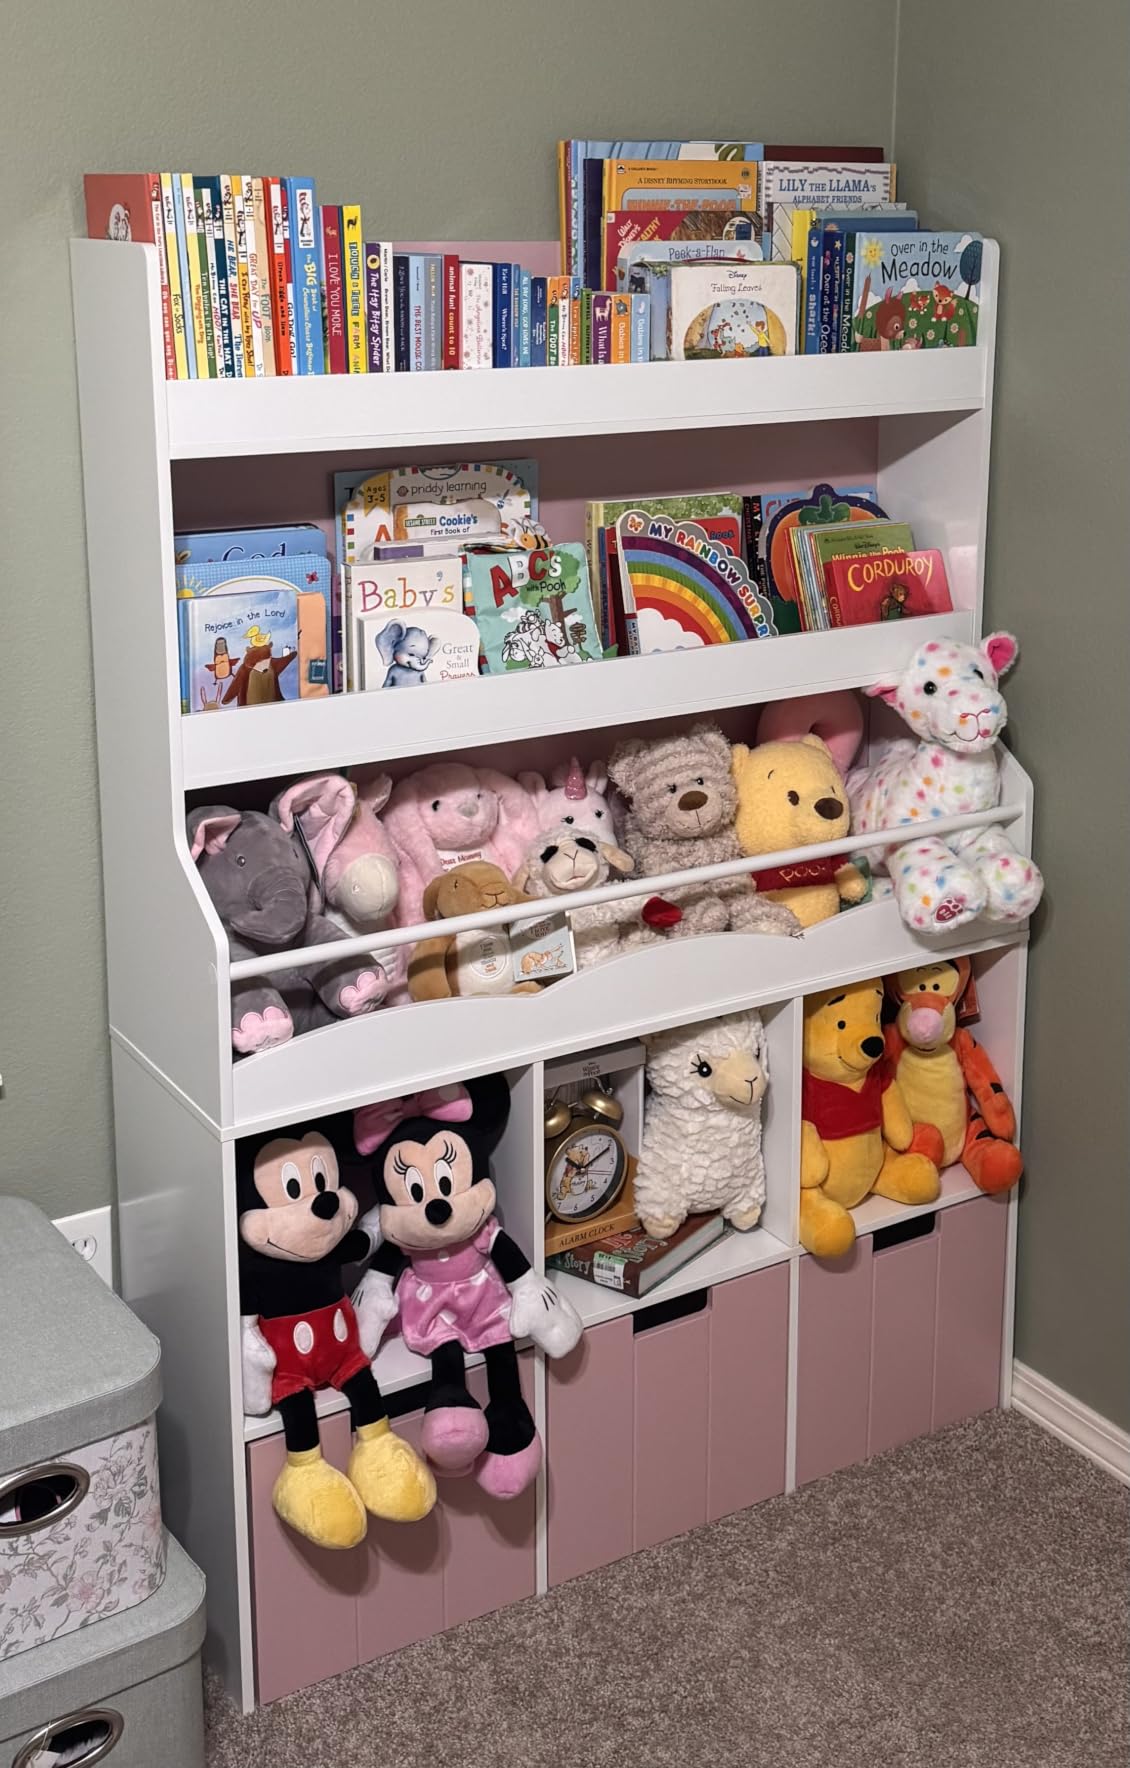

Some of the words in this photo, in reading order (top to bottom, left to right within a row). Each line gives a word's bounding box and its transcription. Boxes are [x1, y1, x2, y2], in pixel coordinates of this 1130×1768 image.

[779, 179, 806, 192] LILY
[809, 183, 826, 192] THE
[828, 180, 876, 192] LLAMA'S
[792, 195, 830, 204] ALPHABET
[832, 195, 862, 204] FRIENDS
[228, 240, 234, 252] HE
[890, 242, 916, 256] Over
[919, 240, 928, 254] in
[932, 239, 948, 254] the
[249, 253, 258, 276] GREAT
[349, 242, 360, 280] TOUCH
[880, 250, 958, 284] Meadow
[304, 262, 318, 286] BIG
[330, 262, 341, 286] LOVE
[370, 273, 380, 288] The
[727, 270, 748, 280] Disney
[218, 278, 228, 295] THE
[230, 282, 238, 300] SHE
[251, 280, 260, 297] DAY
[711, 283, 736, 295] Falling
[738, 282, 763, 292] Leaves
[824, 274, 832, 294] Over
[173, 294, 181, 306] Fox
[202, 288, 210, 315] Apples
[242, 292, 251, 310] Read
[331, 286, 342, 306] YOU
[369, 289, 380, 308] Itsy
[824, 296, 830, 305] at
[221, 298, 230, 316] CAT
[232, 302, 241, 320] BEAR
[261, 294, 271, 321] FOOT
[822, 308, 831, 322] the
[174, 314, 184, 334] Socks
[213, 306, 221, 332] MOO!
[222, 318, 230, 327] IN
[252, 310, 262, 328] UP
[332, 309, 342, 336] MORE
[370, 310, 381, 336] Bitsy
[234, 334, 244, 352] The
[352, 322, 360, 350] FARM
[449, 336, 455, 345] to
[550, 333, 558, 355] FOOT
[598, 326, 608, 350] What
[618, 322, 626, 350] Babies
[246, 350, 254, 367] Shut!
[371, 336, 382, 366] Spider
[449, 346, 456, 356] 10
[598, 350, 607, 358] Is
[618, 350, 625, 359] in
[411, 482, 444, 497] priddy
[446, 482, 487, 495] learning
[368, 494, 386, 504] 3-5
[439, 514, 478, 526] Cookie's
[752, 502, 762, 521] MY
[445, 528, 460, 536] Book
[648, 522, 673, 540] MY
[675, 530, 742, 584] RAINBOW
[738, 584, 771, 638] SURPR
[847, 555, 932, 592] CORDUROY
[540, 578, 566, 592] Pooh
[204, 620, 233, 634] Rejoice
[247, 612, 260, 620] the
[264, 608, 286, 618] Lord
[442, 642, 473, 654] Great
[446, 658, 470, 670] Small
[560, 1232, 588, 1247] ALARM
[588, 1222, 614, 1238] CLOCK
[564, 1252, 592, 1275] Story
